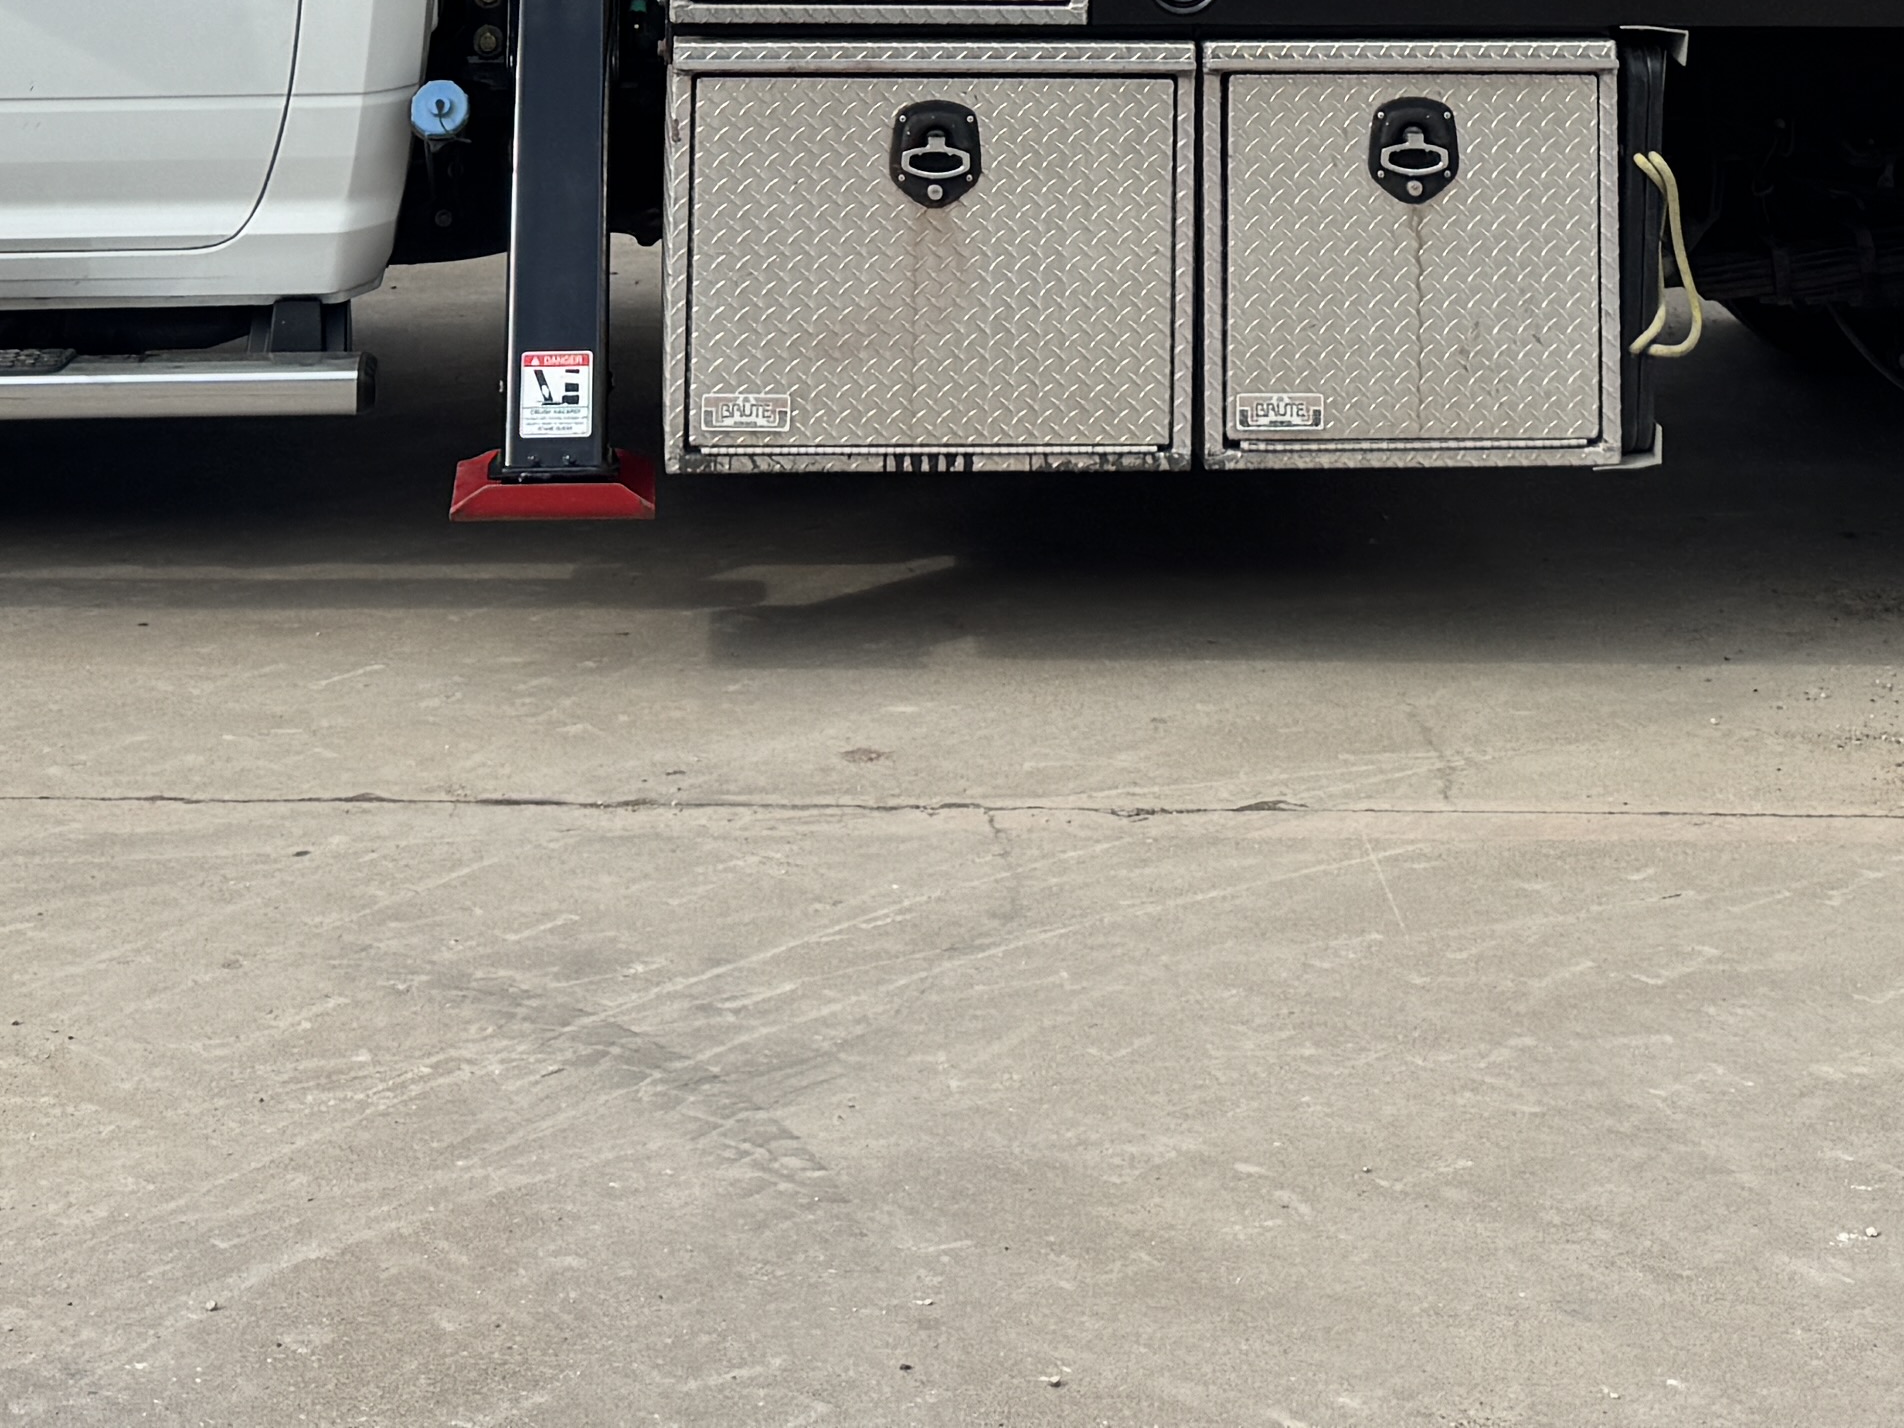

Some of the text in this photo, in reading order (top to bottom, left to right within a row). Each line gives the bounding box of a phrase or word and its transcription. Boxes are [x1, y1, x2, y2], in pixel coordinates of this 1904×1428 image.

[543, 355, 584, 366] DANGER
[720, 403, 772, 418] BRUTE
[1255, 402, 1306, 418] BRUTE
